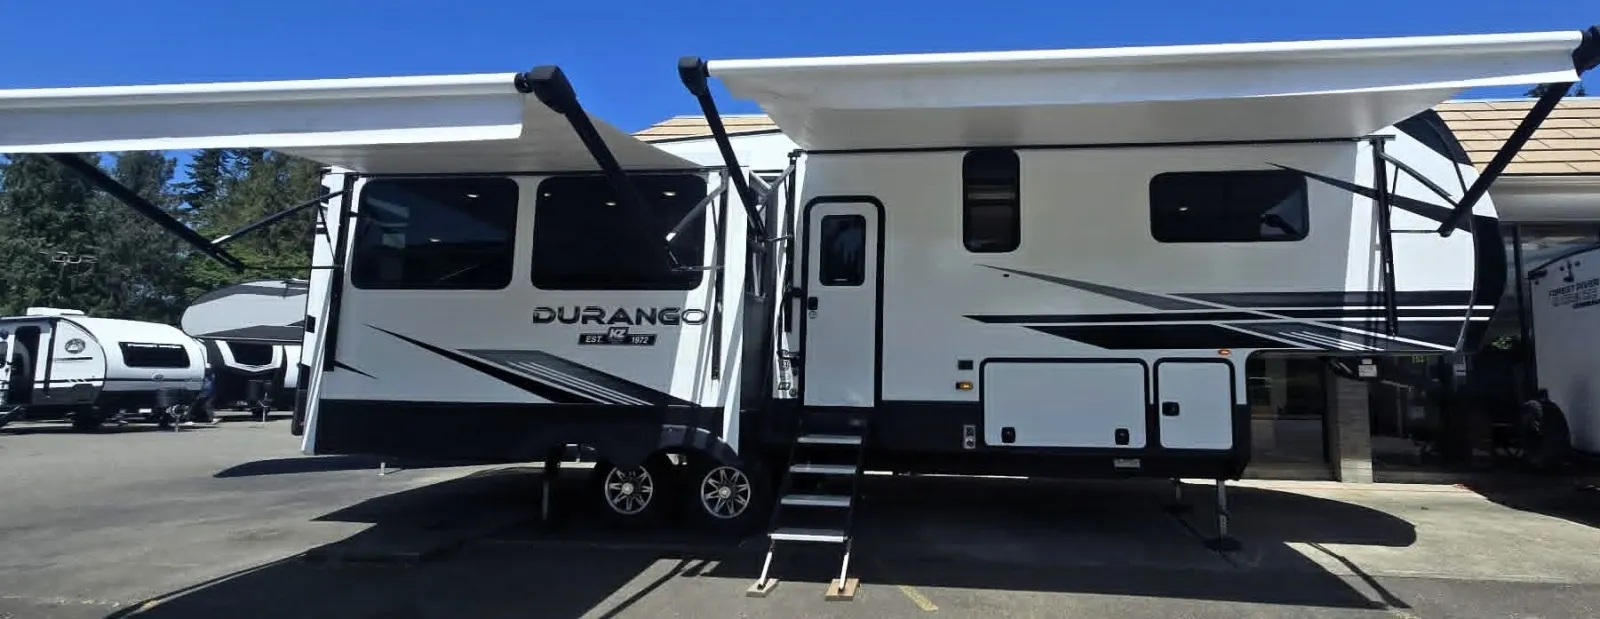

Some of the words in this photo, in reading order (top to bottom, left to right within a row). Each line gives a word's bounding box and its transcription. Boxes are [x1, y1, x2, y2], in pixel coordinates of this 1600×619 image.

[532, 306, 708, 326] DURANGO
[609, 328, 627, 338] KZ
[585, 335, 603, 343] EST.
[631, 336, 649, 344] 1972
